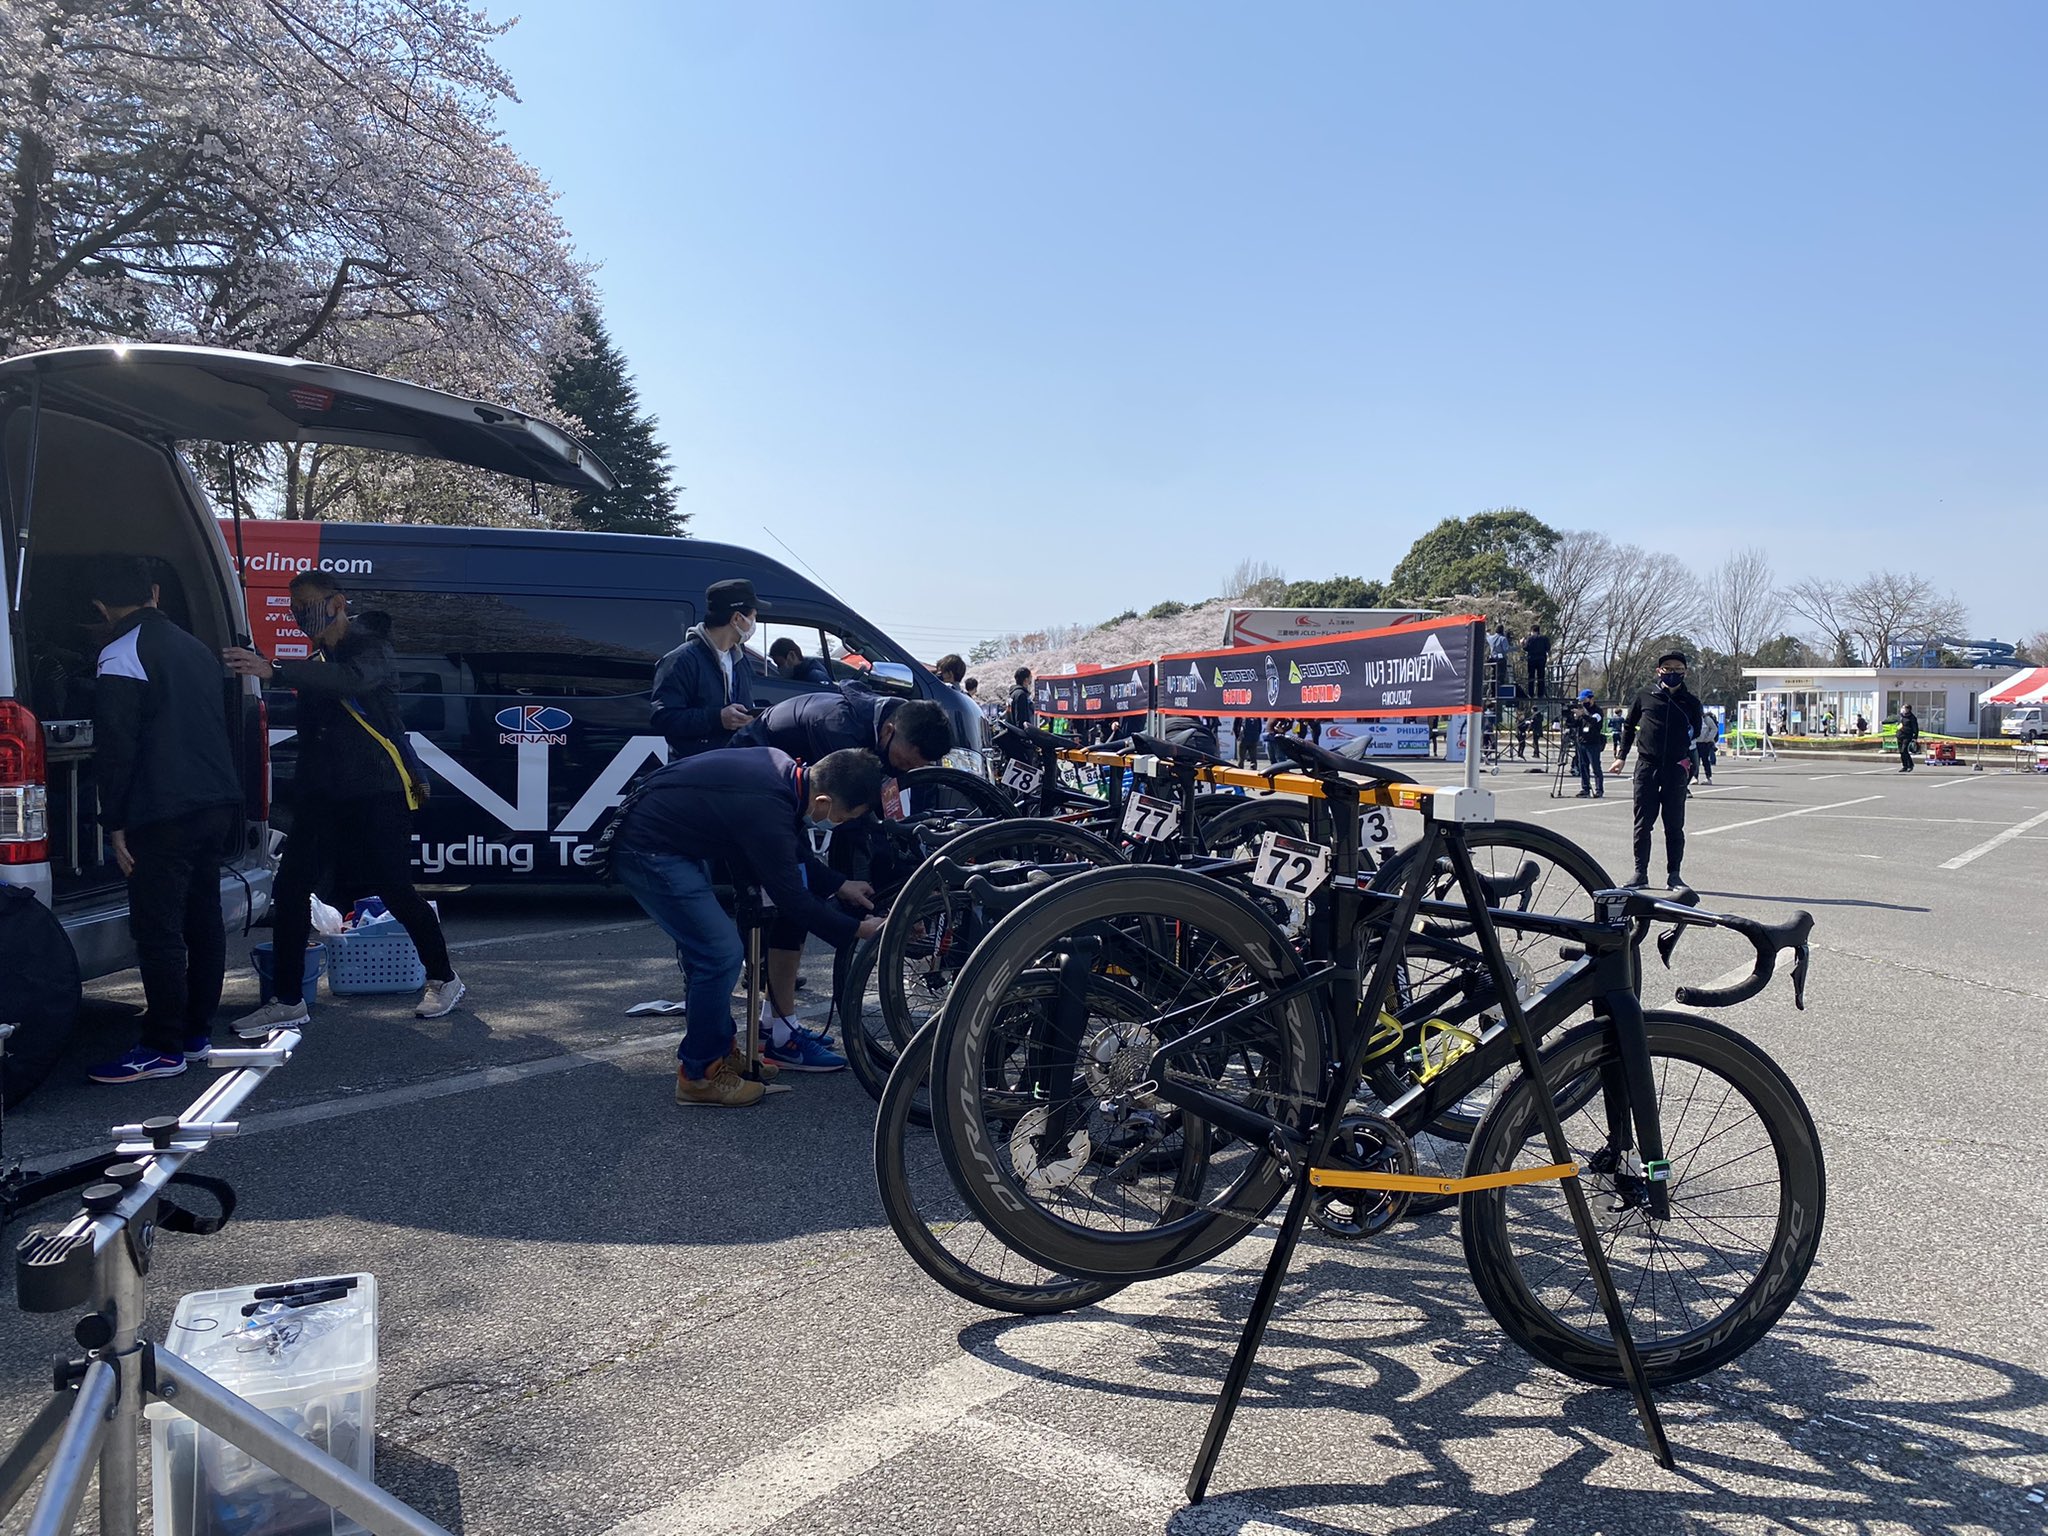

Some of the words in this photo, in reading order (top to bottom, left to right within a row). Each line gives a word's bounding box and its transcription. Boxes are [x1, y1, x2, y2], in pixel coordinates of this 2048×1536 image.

[499, 733, 567, 745] KINAN
[1396, 727, 1429, 735] PHILIPS
[1009, 767, 1034, 791] 78
[1133, 806, 1169, 837] 77
[549, 836, 595, 866] Te
[1266, 849, 1312, 894] 72
